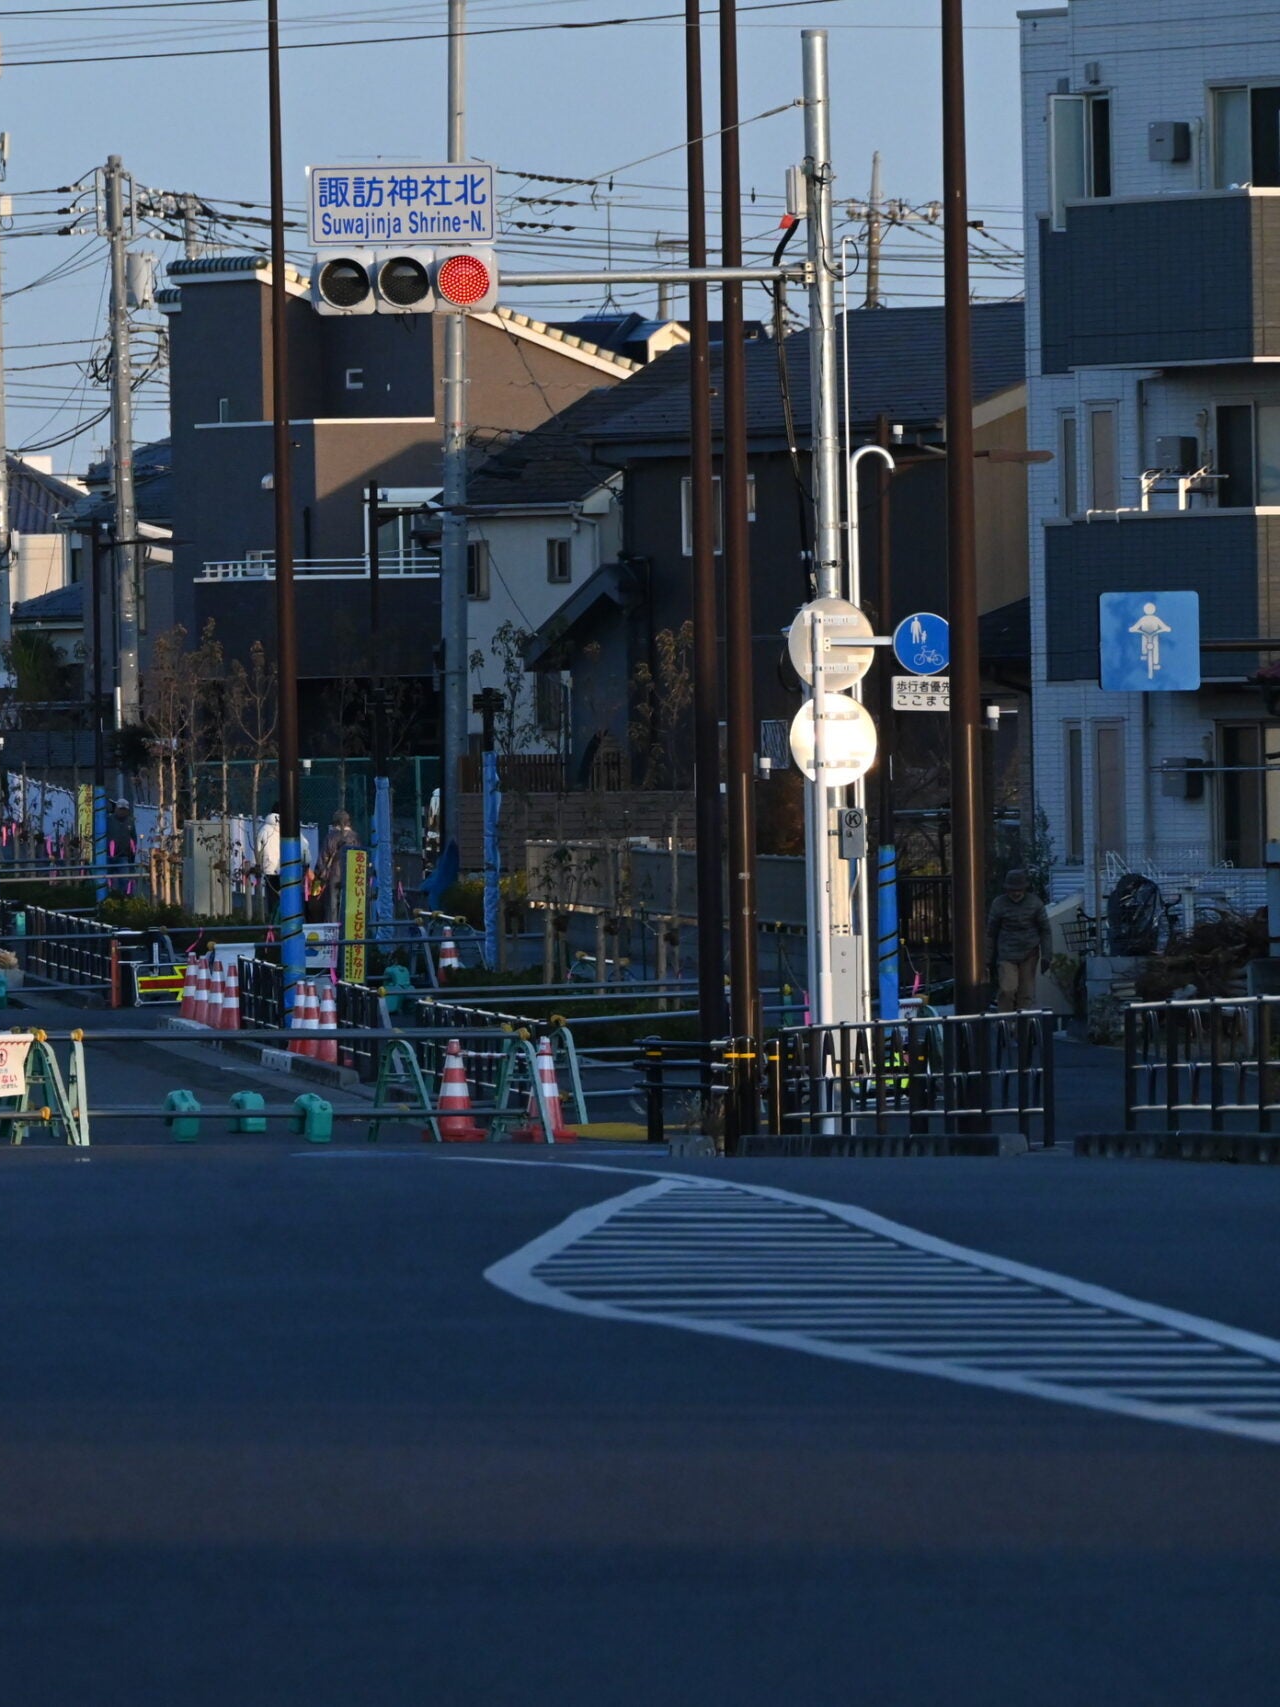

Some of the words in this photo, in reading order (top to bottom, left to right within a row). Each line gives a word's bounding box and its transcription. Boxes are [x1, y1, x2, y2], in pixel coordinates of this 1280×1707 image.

[318, 174, 486, 207] 諏訪神社北
[322, 212, 402, 239] Suwajinja
[408, 210, 486, 234] Shrine-N.
